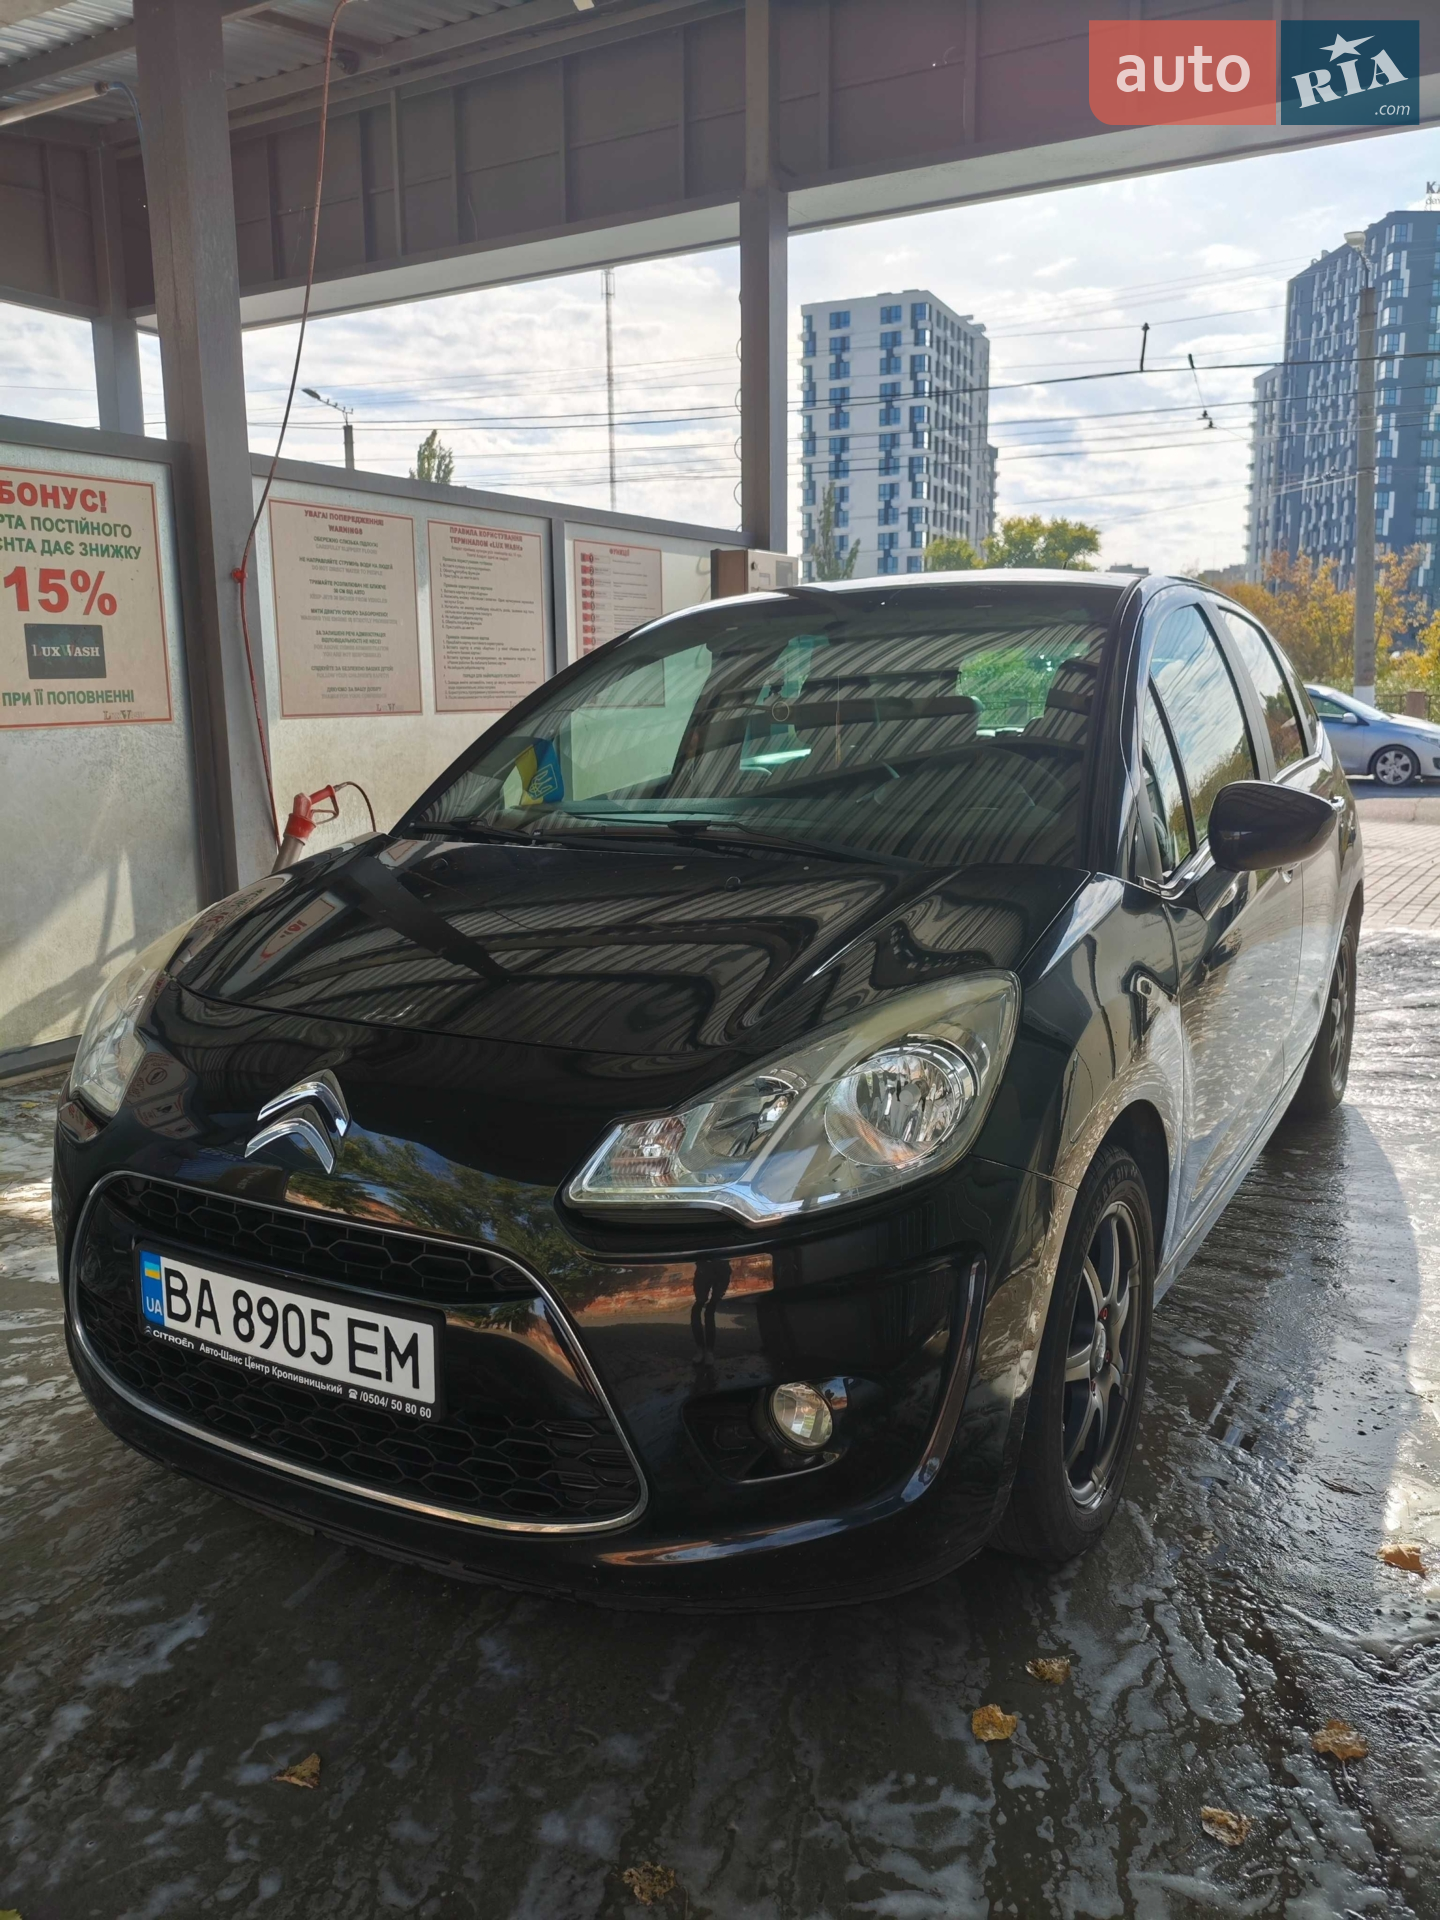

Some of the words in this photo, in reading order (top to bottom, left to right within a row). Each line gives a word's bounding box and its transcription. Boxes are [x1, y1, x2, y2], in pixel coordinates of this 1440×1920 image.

[31, 516, 132, 538] ПОСТІЙНОГО
[41, 539, 75, 556] ДАЄ
[79, 542, 141, 560] ЗНИЖКУ
[3, 566, 117, 616] 15%
[2, 692, 31, 707] ПРИ
[34, 689, 43, 705] ЇЇ
[47, 689, 134, 705] ПОПОВНЕННІ
[146, 1299, 163, 1316] UA
[164, 1267, 221, 1335] BA
[233, 1289, 333, 1366] 8905
[347, 1316, 420, 1390] EM
[200, 1342, 243, 1366] Авто-Шанс
[245, 1355, 270, 1375] Центр
[272, 1364, 343, 1395] Кропивницький
[360, 1390, 388, 1408] /0504/
[391, 1399, 402, 1412] 50
[405, 1402, 417, 1415] 80
[420, 1406, 432, 1419] 60
